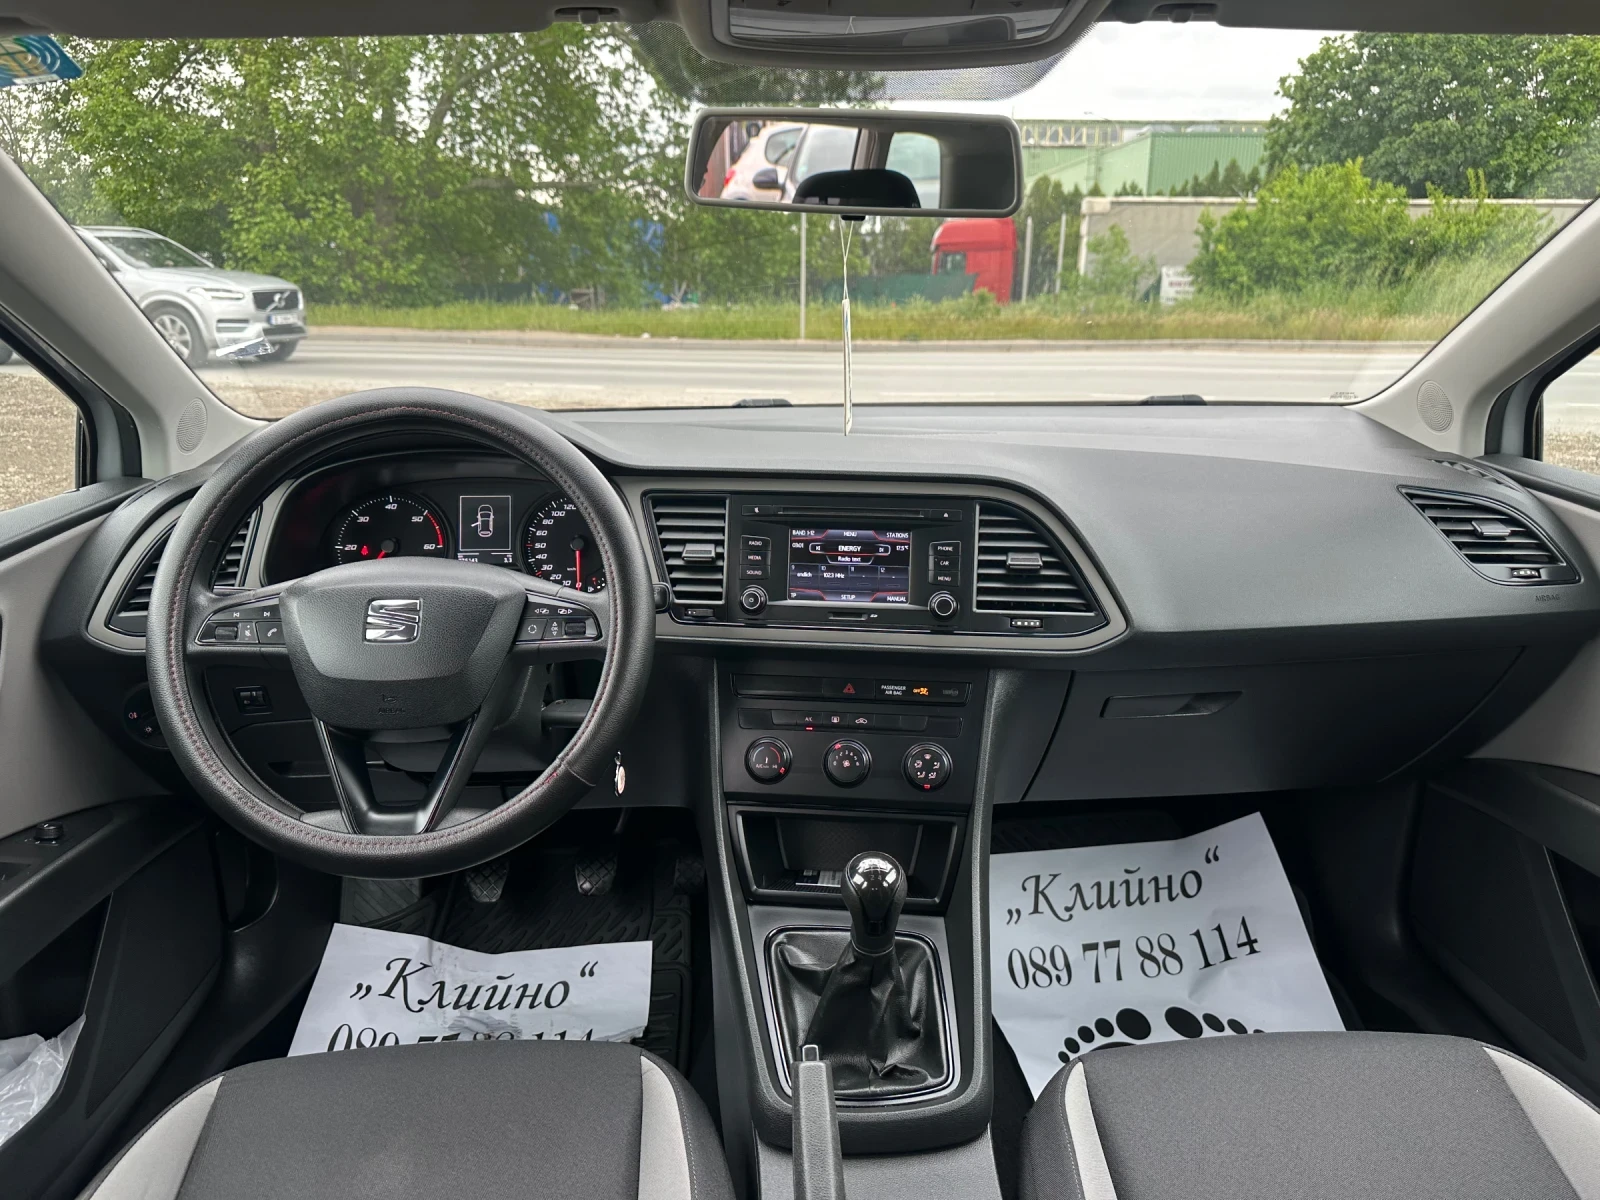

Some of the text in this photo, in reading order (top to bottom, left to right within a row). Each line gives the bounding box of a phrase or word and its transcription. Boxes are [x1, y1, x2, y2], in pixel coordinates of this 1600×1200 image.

[1007, 915, 1261, 990] 089 77 88 114
